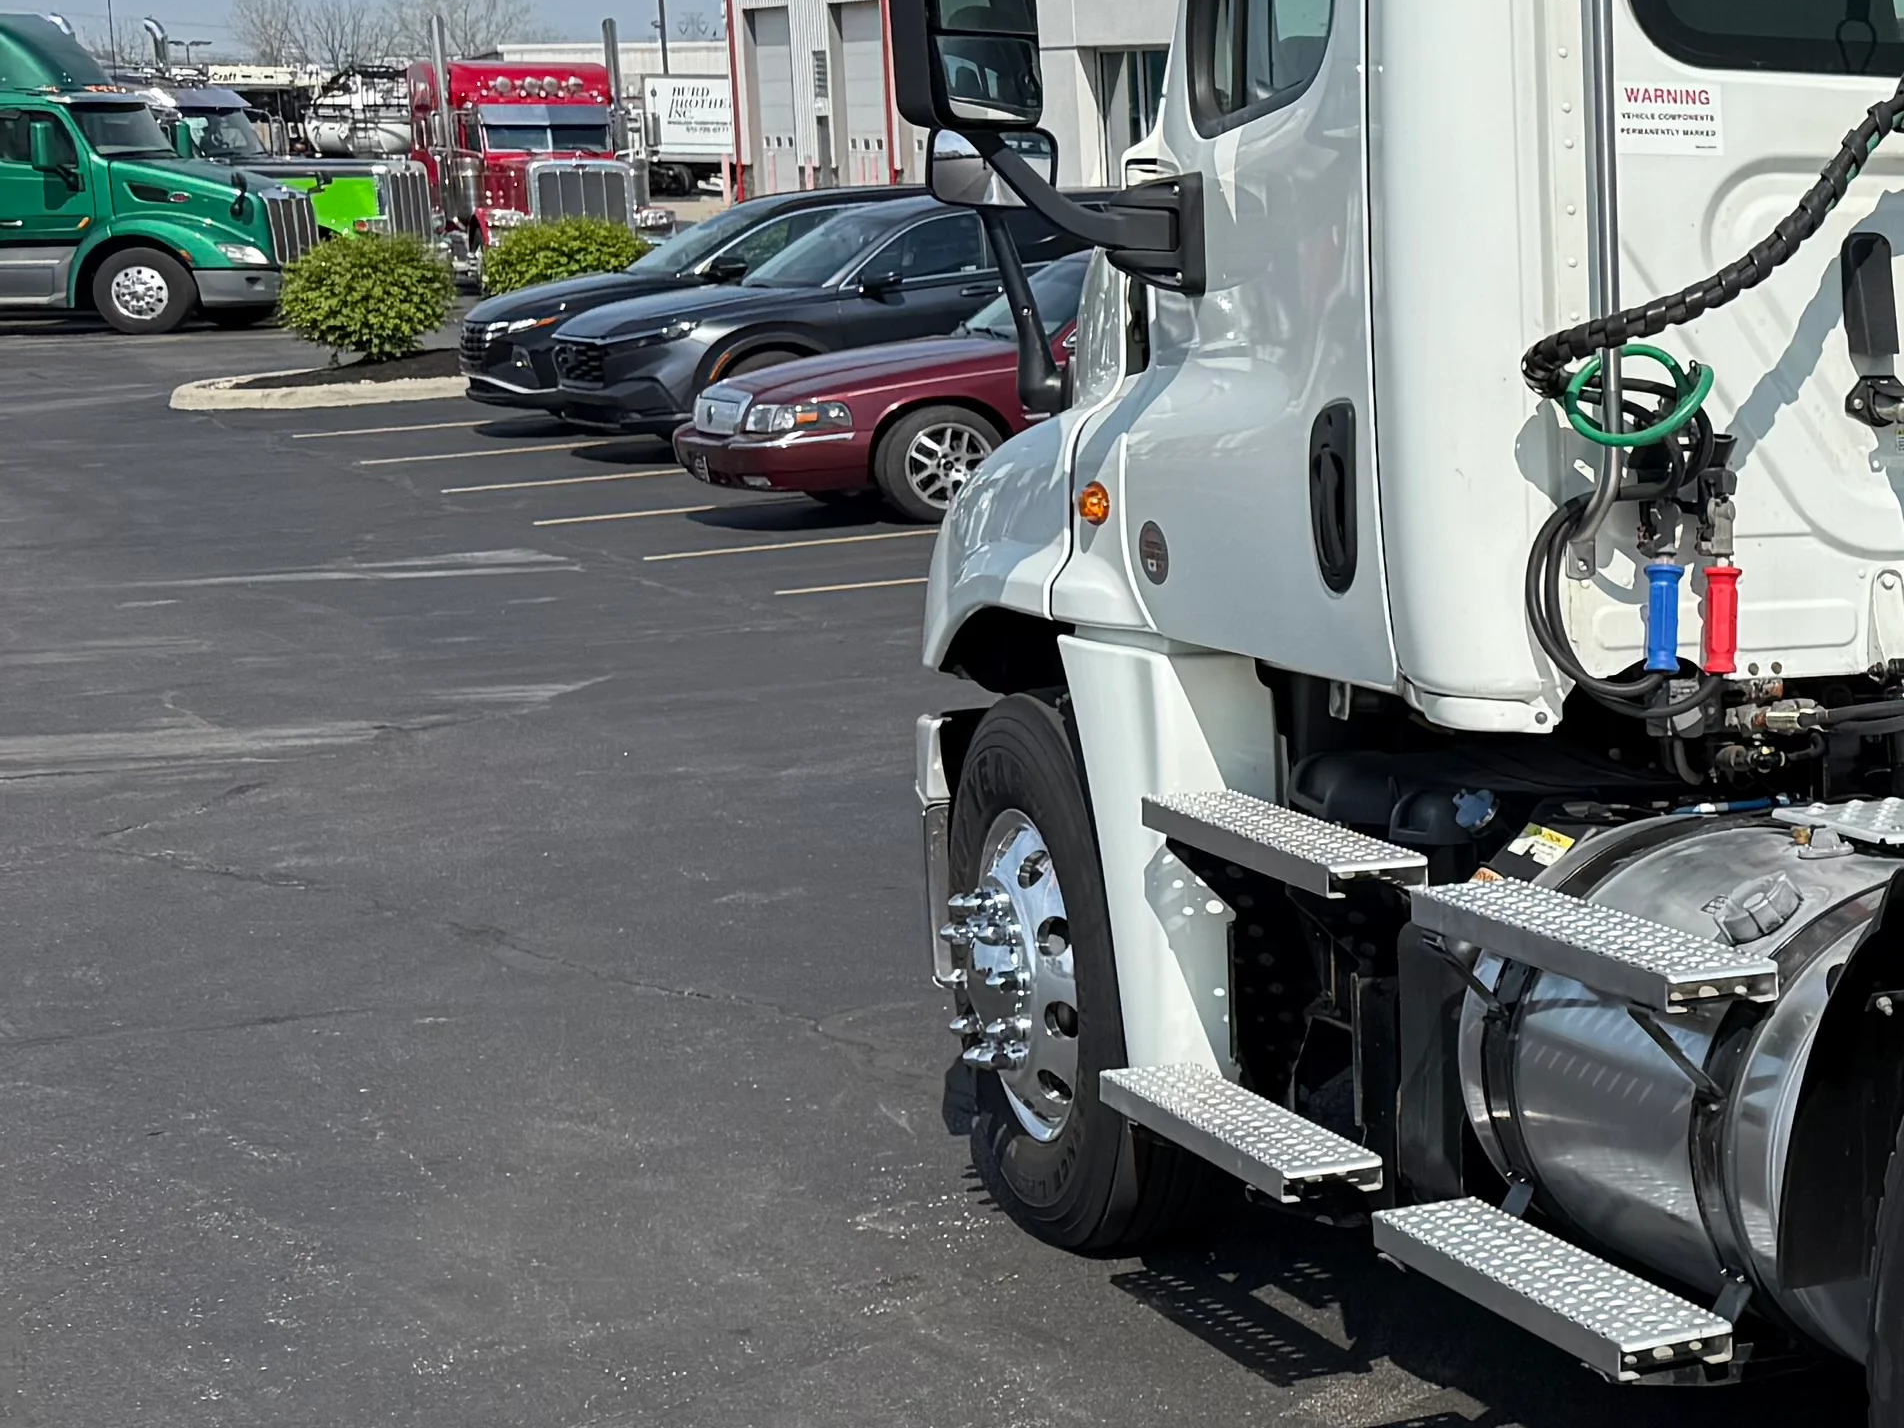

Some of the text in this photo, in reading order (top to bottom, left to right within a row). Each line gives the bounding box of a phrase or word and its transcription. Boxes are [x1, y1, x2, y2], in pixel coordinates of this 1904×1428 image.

[1624, 87, 1710, 106] WARNING
[1620, 112, 1715, 122] VEHICLE COMPONENTS
[1620, 127, 1717, 137] PERMANENTLY MARKED
